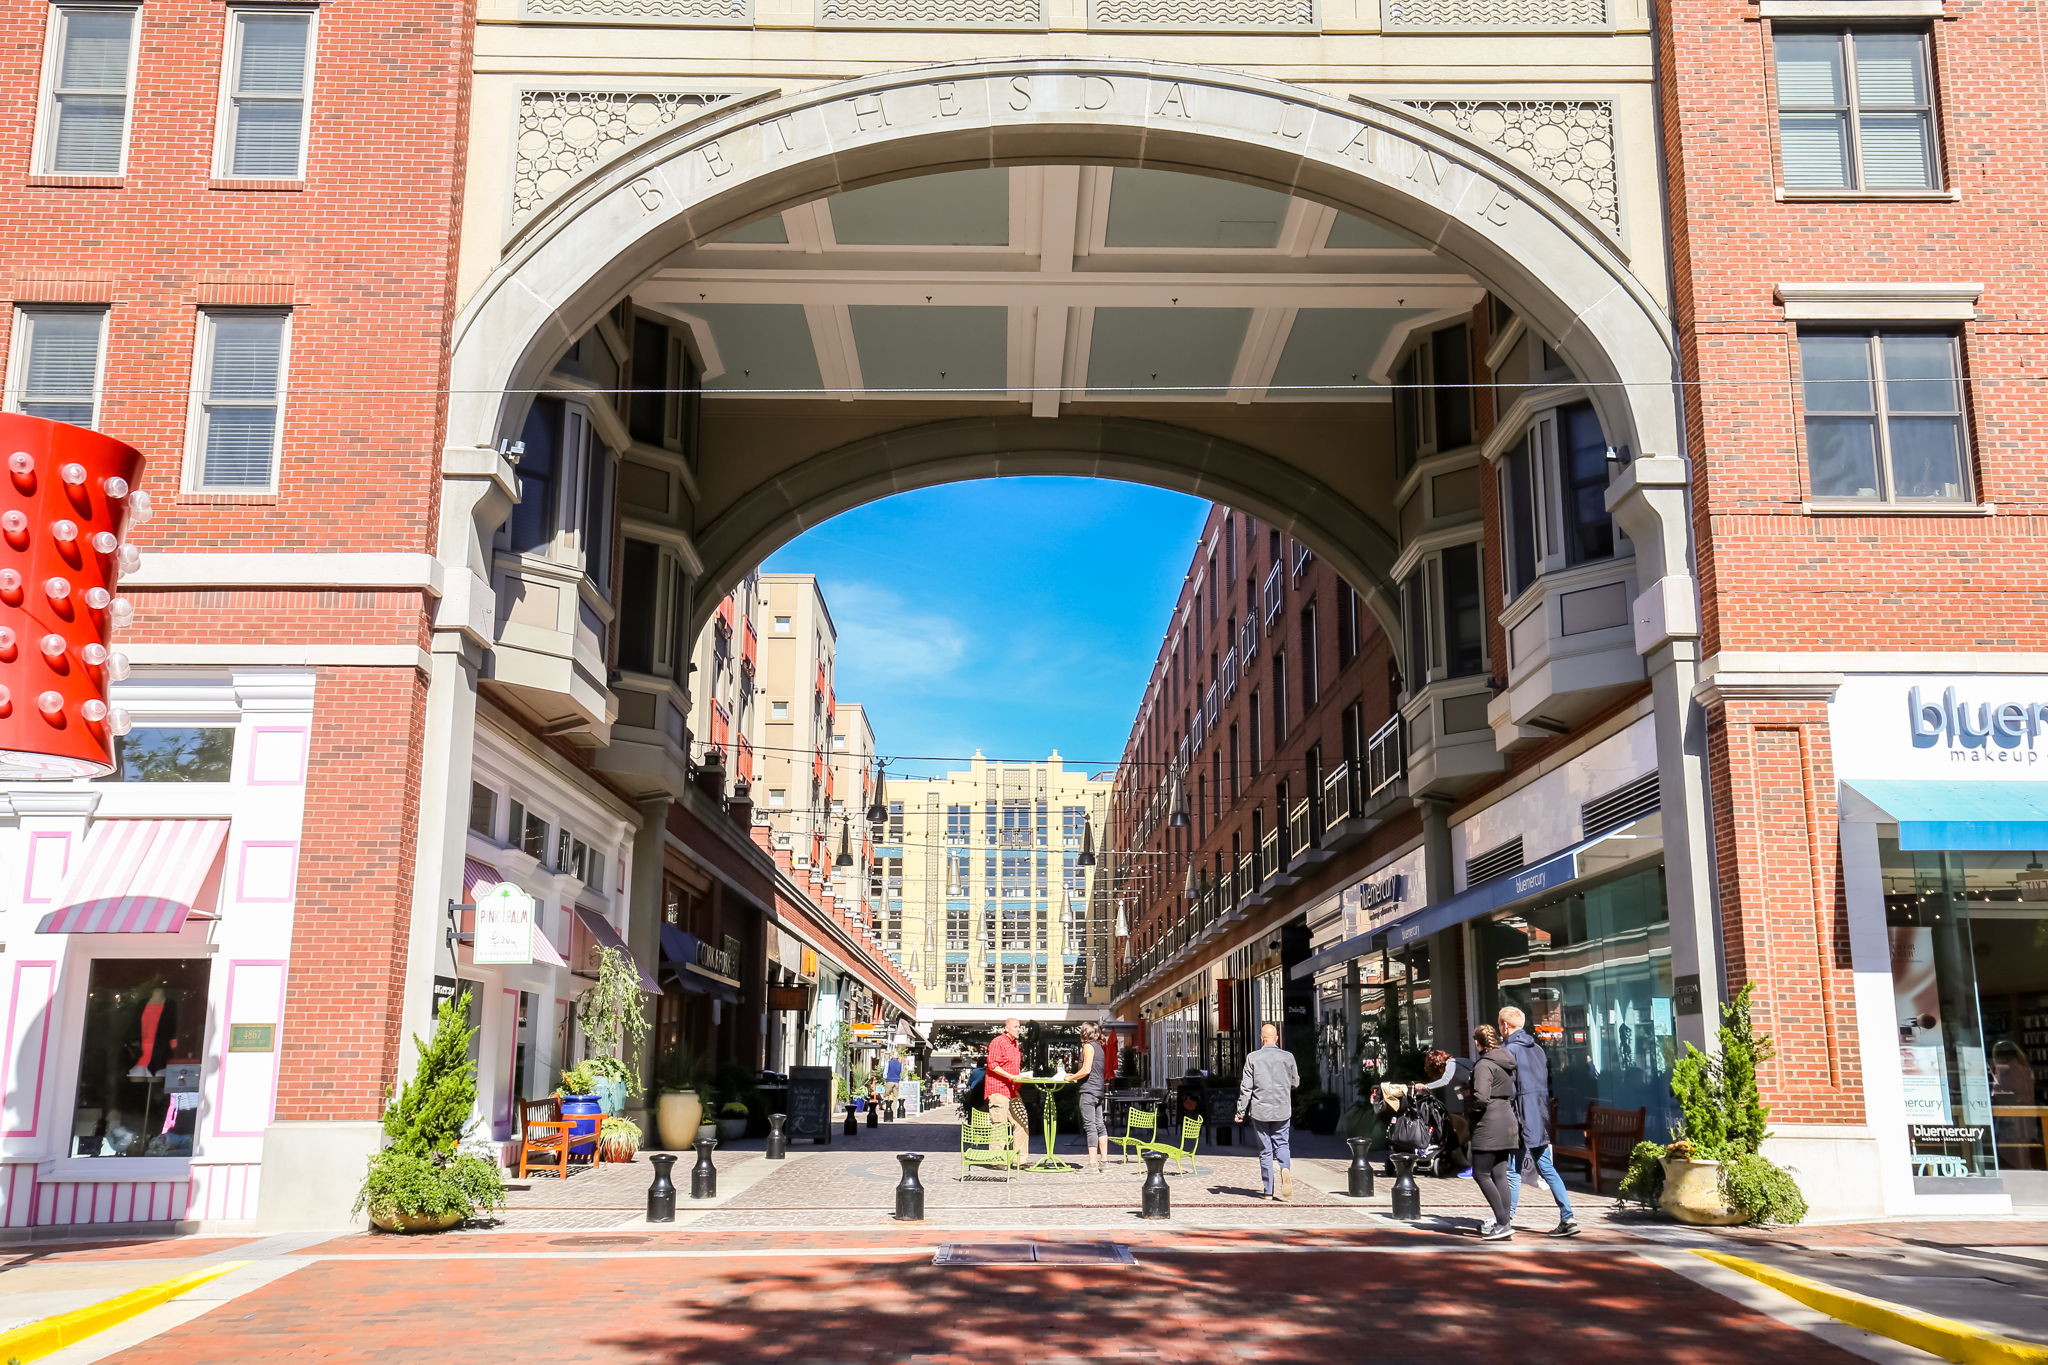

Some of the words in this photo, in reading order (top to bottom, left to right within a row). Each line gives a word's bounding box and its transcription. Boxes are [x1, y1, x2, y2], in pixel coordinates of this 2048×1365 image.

[624, 73, 1192, 217] BETHESDA
[1271, 101, 1519, 228] LANE
[1950, 749, 2038, 766] makeup
[1515, 871, 1546, 894] bluemercury
[1360, 875, 1397, 911] bluemercury
[506, 909, 528, 924] PALM
[1913, 1125, 1985, 1140] bluemercury
